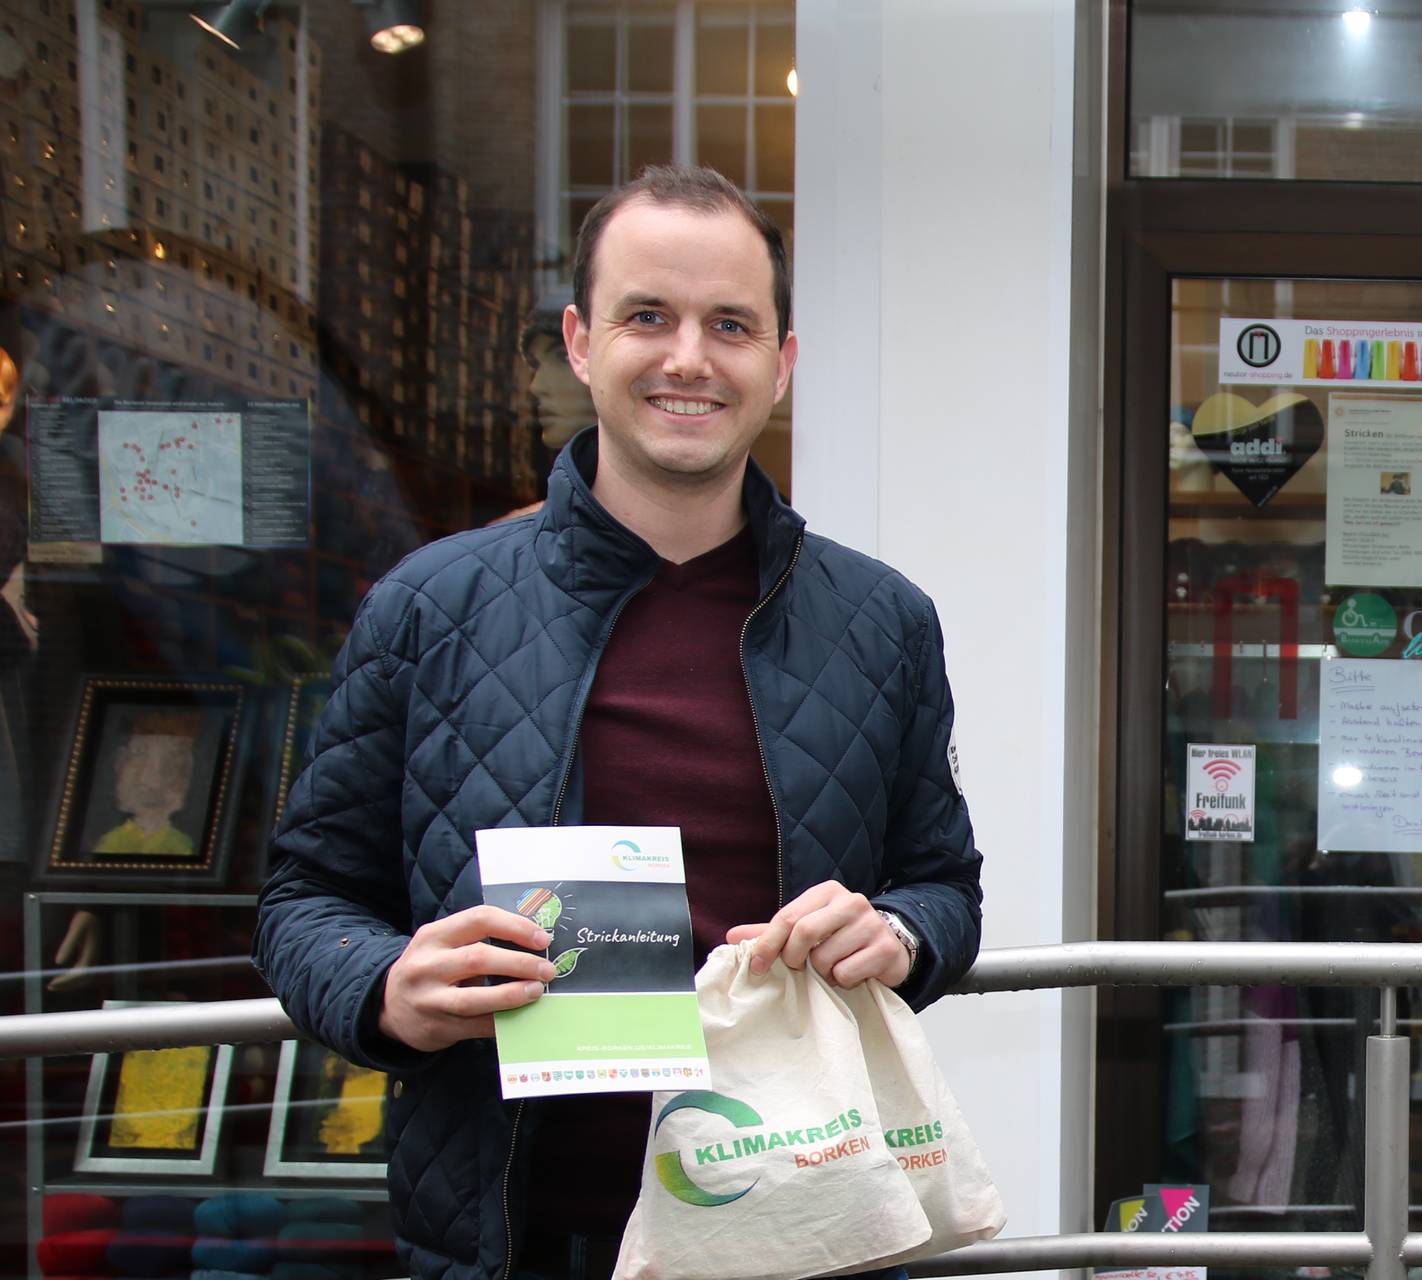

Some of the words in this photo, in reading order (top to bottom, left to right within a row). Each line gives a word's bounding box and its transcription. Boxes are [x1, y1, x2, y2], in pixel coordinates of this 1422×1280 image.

[1304, 326, 1324, 336] Das
[1326, 327, 1415, 339] Shoppingerlebnis
[1344, 428, 1384, 438] Stricken
[1230, 436, 1283, 455] addi
[1329, 666, 1372, 684] Bitte
[1340, 702, 1371, 711] Maske
[1341, 716, 1380, 726] Abstand
[1386, 716, 1421, 727] halten
[1231, 749, 1253, 758] WLAN
[1196, 792, 1246, 809] Freifunk
[622, 855, 670, 863] KLIMAKREIS
[576, 927, 680, 947] Strickanleitung
[695, 1109, 862, 1165] KLIMAKREIS
[884, 1120, 944, 1149] KREIS
[795, 1136, 871, 1169] BORKEN
[896, 1149, 948, 1171] ORKEN
[1161, 1195, 1200, 1232] TION
